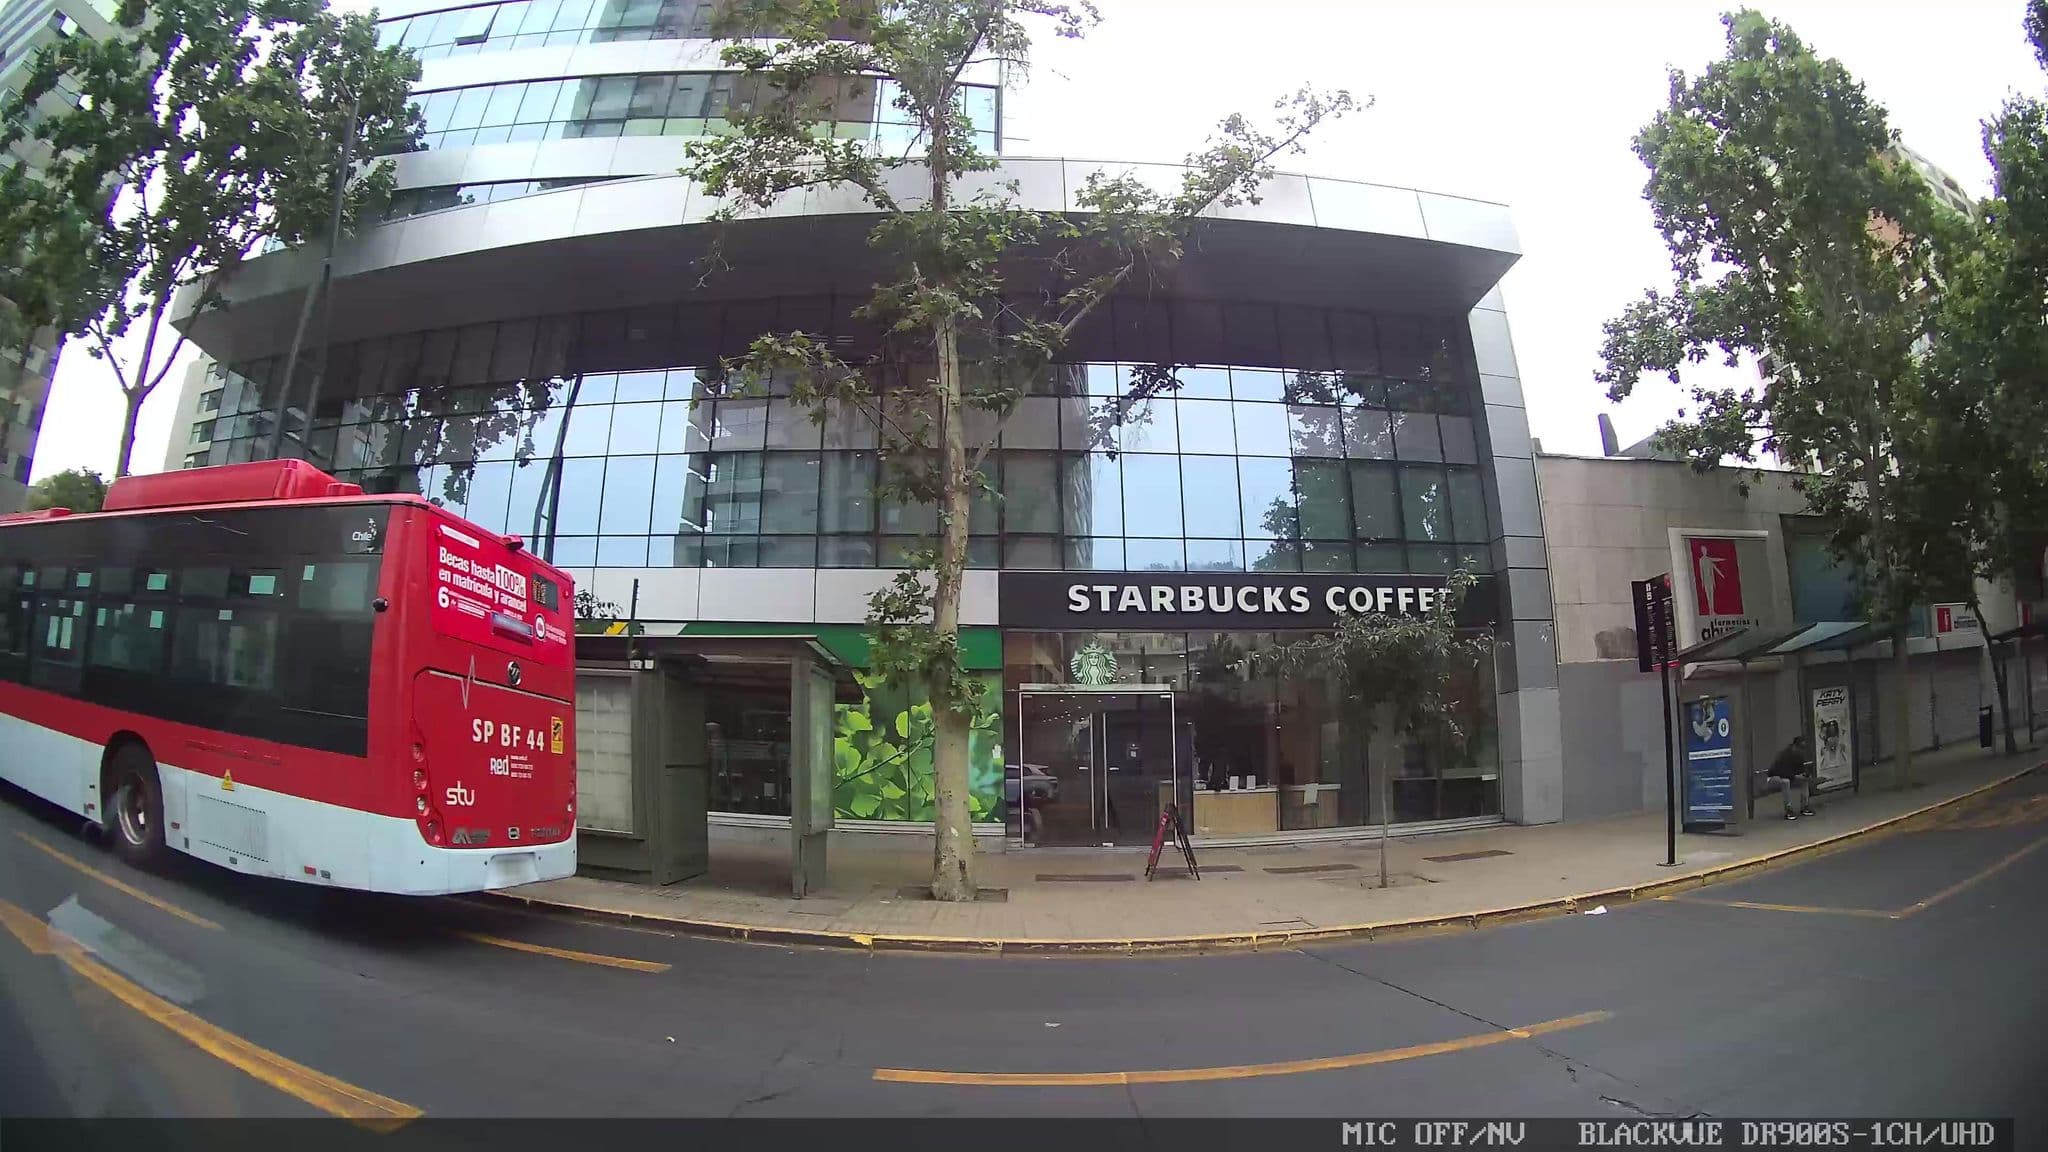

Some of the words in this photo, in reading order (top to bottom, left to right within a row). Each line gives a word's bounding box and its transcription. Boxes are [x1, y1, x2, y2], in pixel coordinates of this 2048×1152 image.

[440, 546, 470, 573] Becas
[471, 559, 495, 583] hasta
[497, 568, 525, 597] 100%
[438, 586, 450, 608] 6
[439, 569, 451, 583] en
[494, 589, 500, 604] y
[1067, 584, 1311, 613] STARBUCKS
[1815, 696, 1846, 708] PERRY
[1820, 689, 1843, 699] KATY
[472, 718, 494, 743] SP
[501, 723, 521, 748] BF
[526, 729, 544, 751] 44
[446, 780, 475, 806] stu
